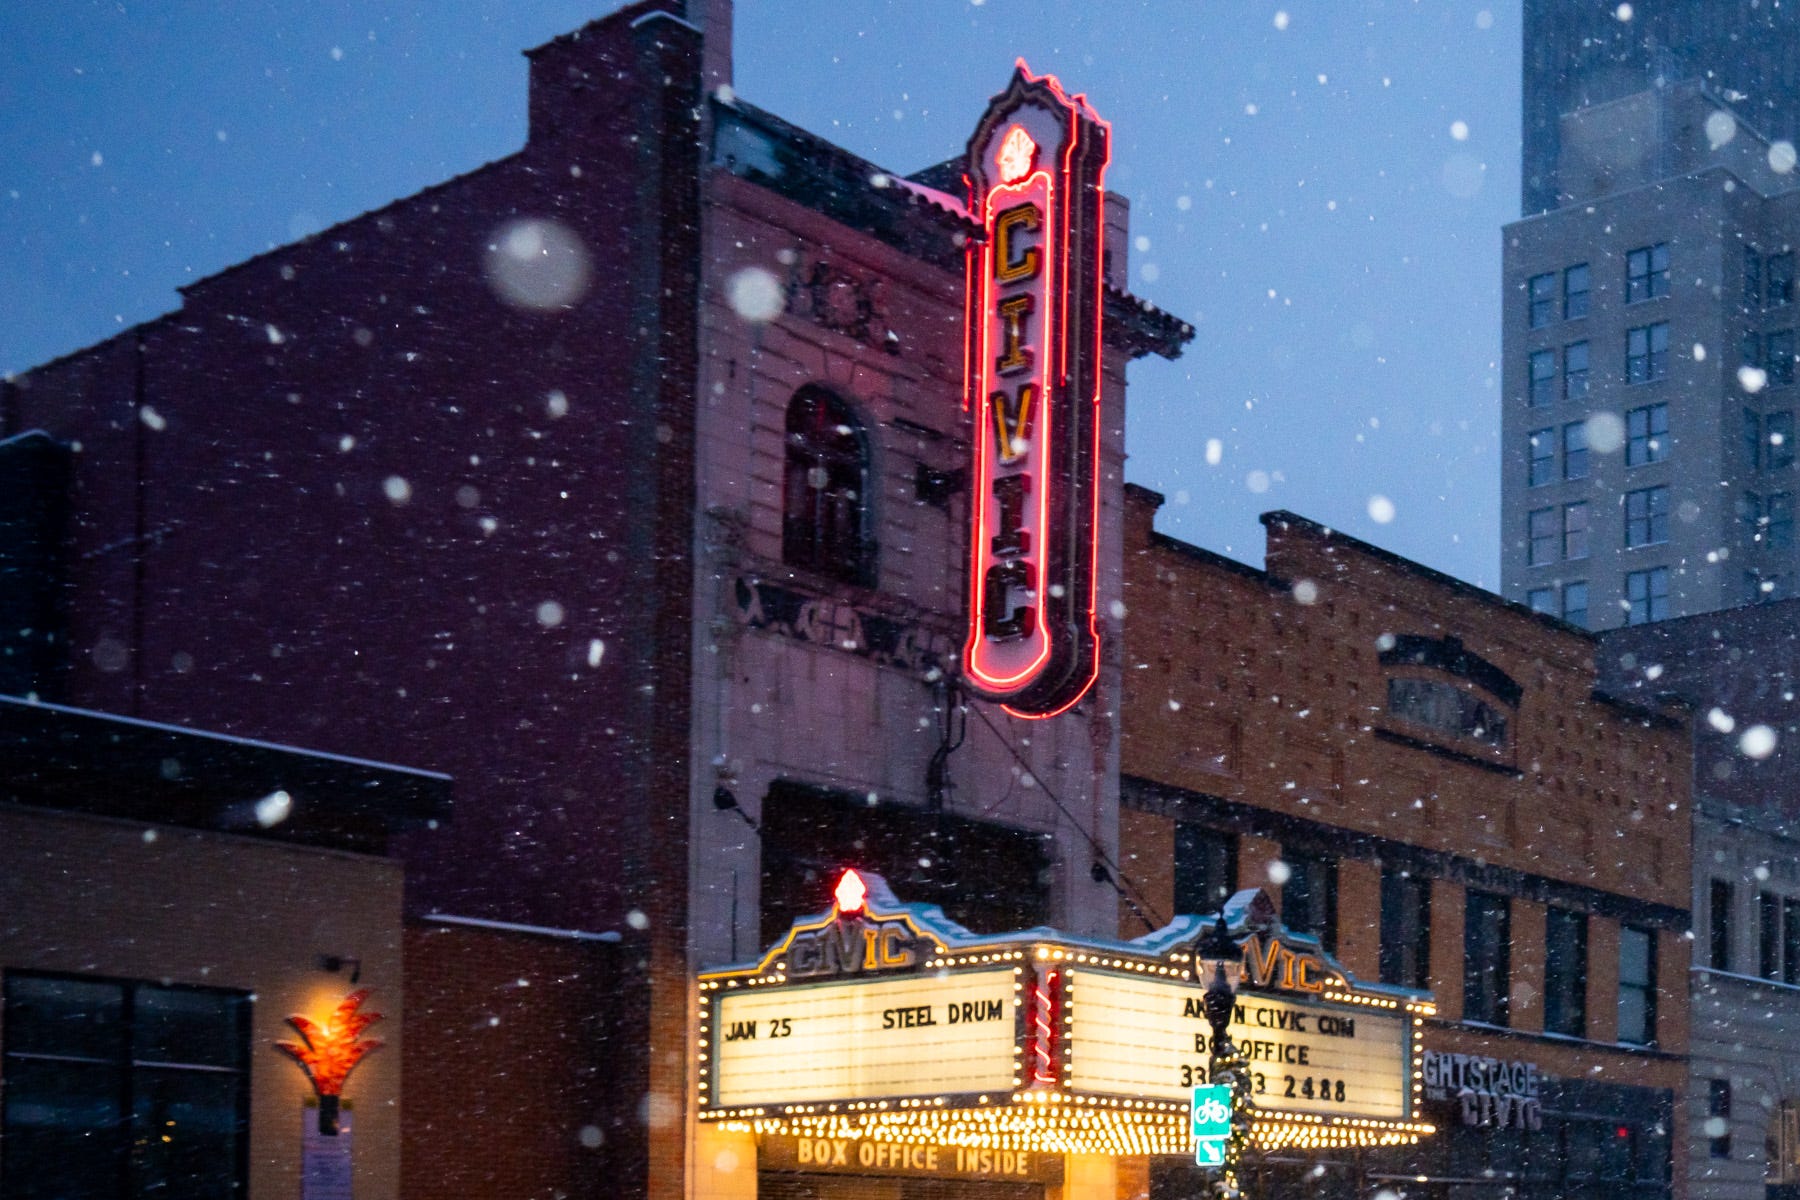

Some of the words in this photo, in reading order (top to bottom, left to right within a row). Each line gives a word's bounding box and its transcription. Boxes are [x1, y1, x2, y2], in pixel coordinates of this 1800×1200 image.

[985, 202, 1042, 644] CIVIC
[787, 922, 914, 976] CIVIC
[1241, 934, 1323, 993] VIC
[725, 1020, 756, 1041] JAN
[770, 1018, 791, 1038] 25
[883, 1005, 936, 1029] STEEL
[948, 1000, 1003, 1024] DRUM
[1183, 998, 1245, 1025] AKN
[1256, 1007, 1306, 1032] CIVIC
[1318, 1015, 1355, 1038] COM
[1241, 1039, 1309, 1065] OFFICE
[1423, 1050, 1538, 1095] GHTSTAGE
[1284, 1075, 1346, 1102] 2488
[1460, 1086, 1542, 1130] CIVIC
[798, 1138, 848, 1165] BOX
[859, 1141, 938, 1170] OFFICE
[956, 1148, 1028, 1174] INSIDE
